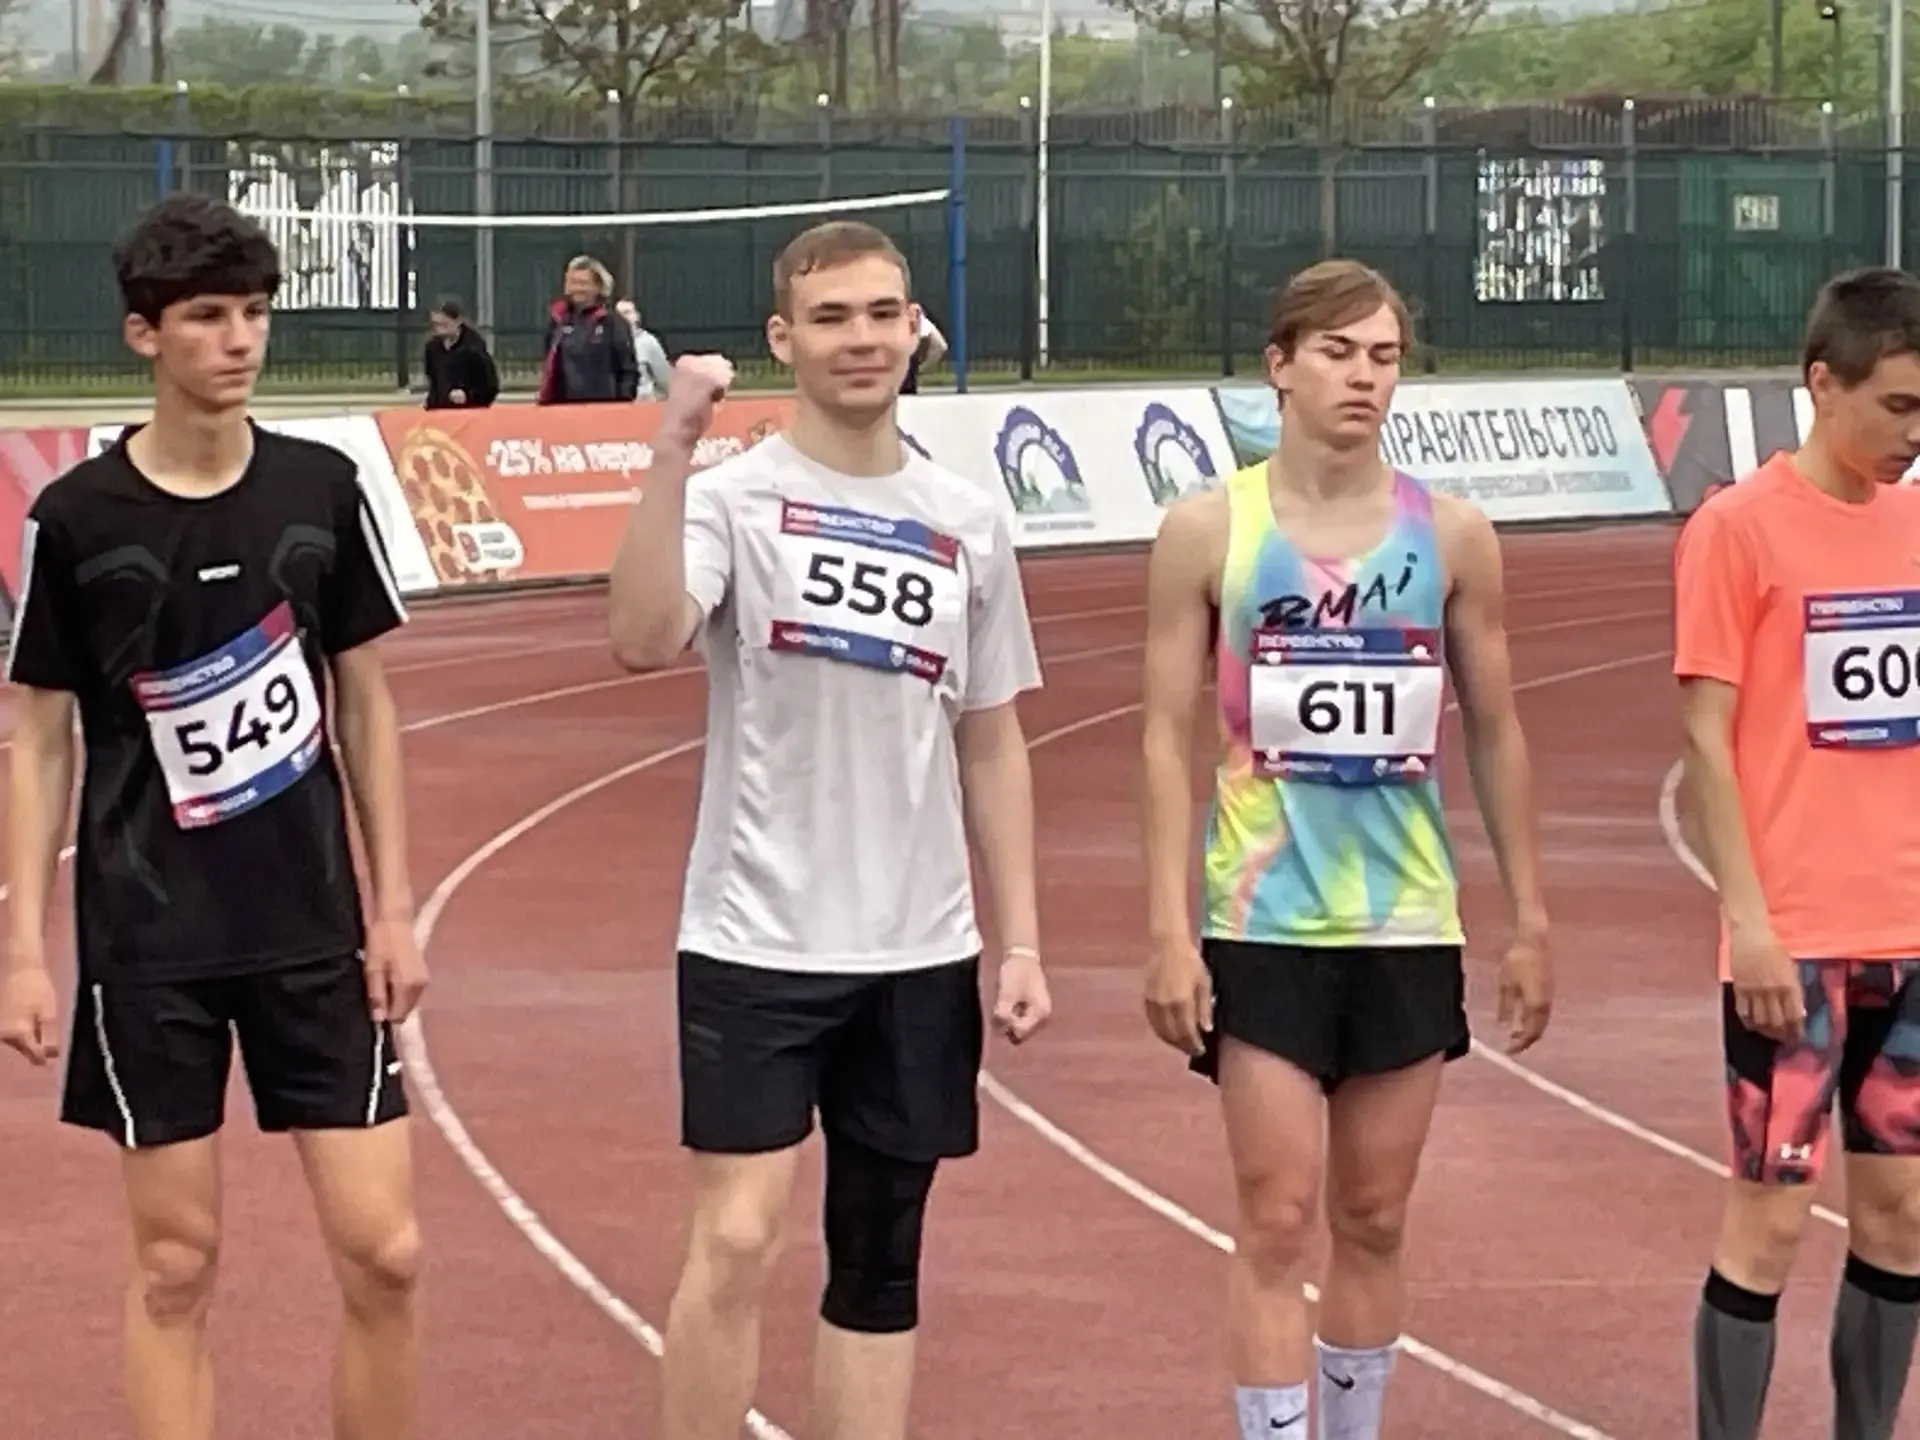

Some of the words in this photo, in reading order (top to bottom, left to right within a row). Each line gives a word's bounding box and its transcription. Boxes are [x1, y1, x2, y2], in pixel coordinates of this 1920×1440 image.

[486, 438, 552, 478] -25%
[1379, 404, 1619, 464] ПРАВИТЕЛЬСТВО
[801, 551, 934, 628] 558
[1831, 643, 1920, 702] 60
[175, 672, 300, 777] 549
[1298, 680, 1396, 736] 611
